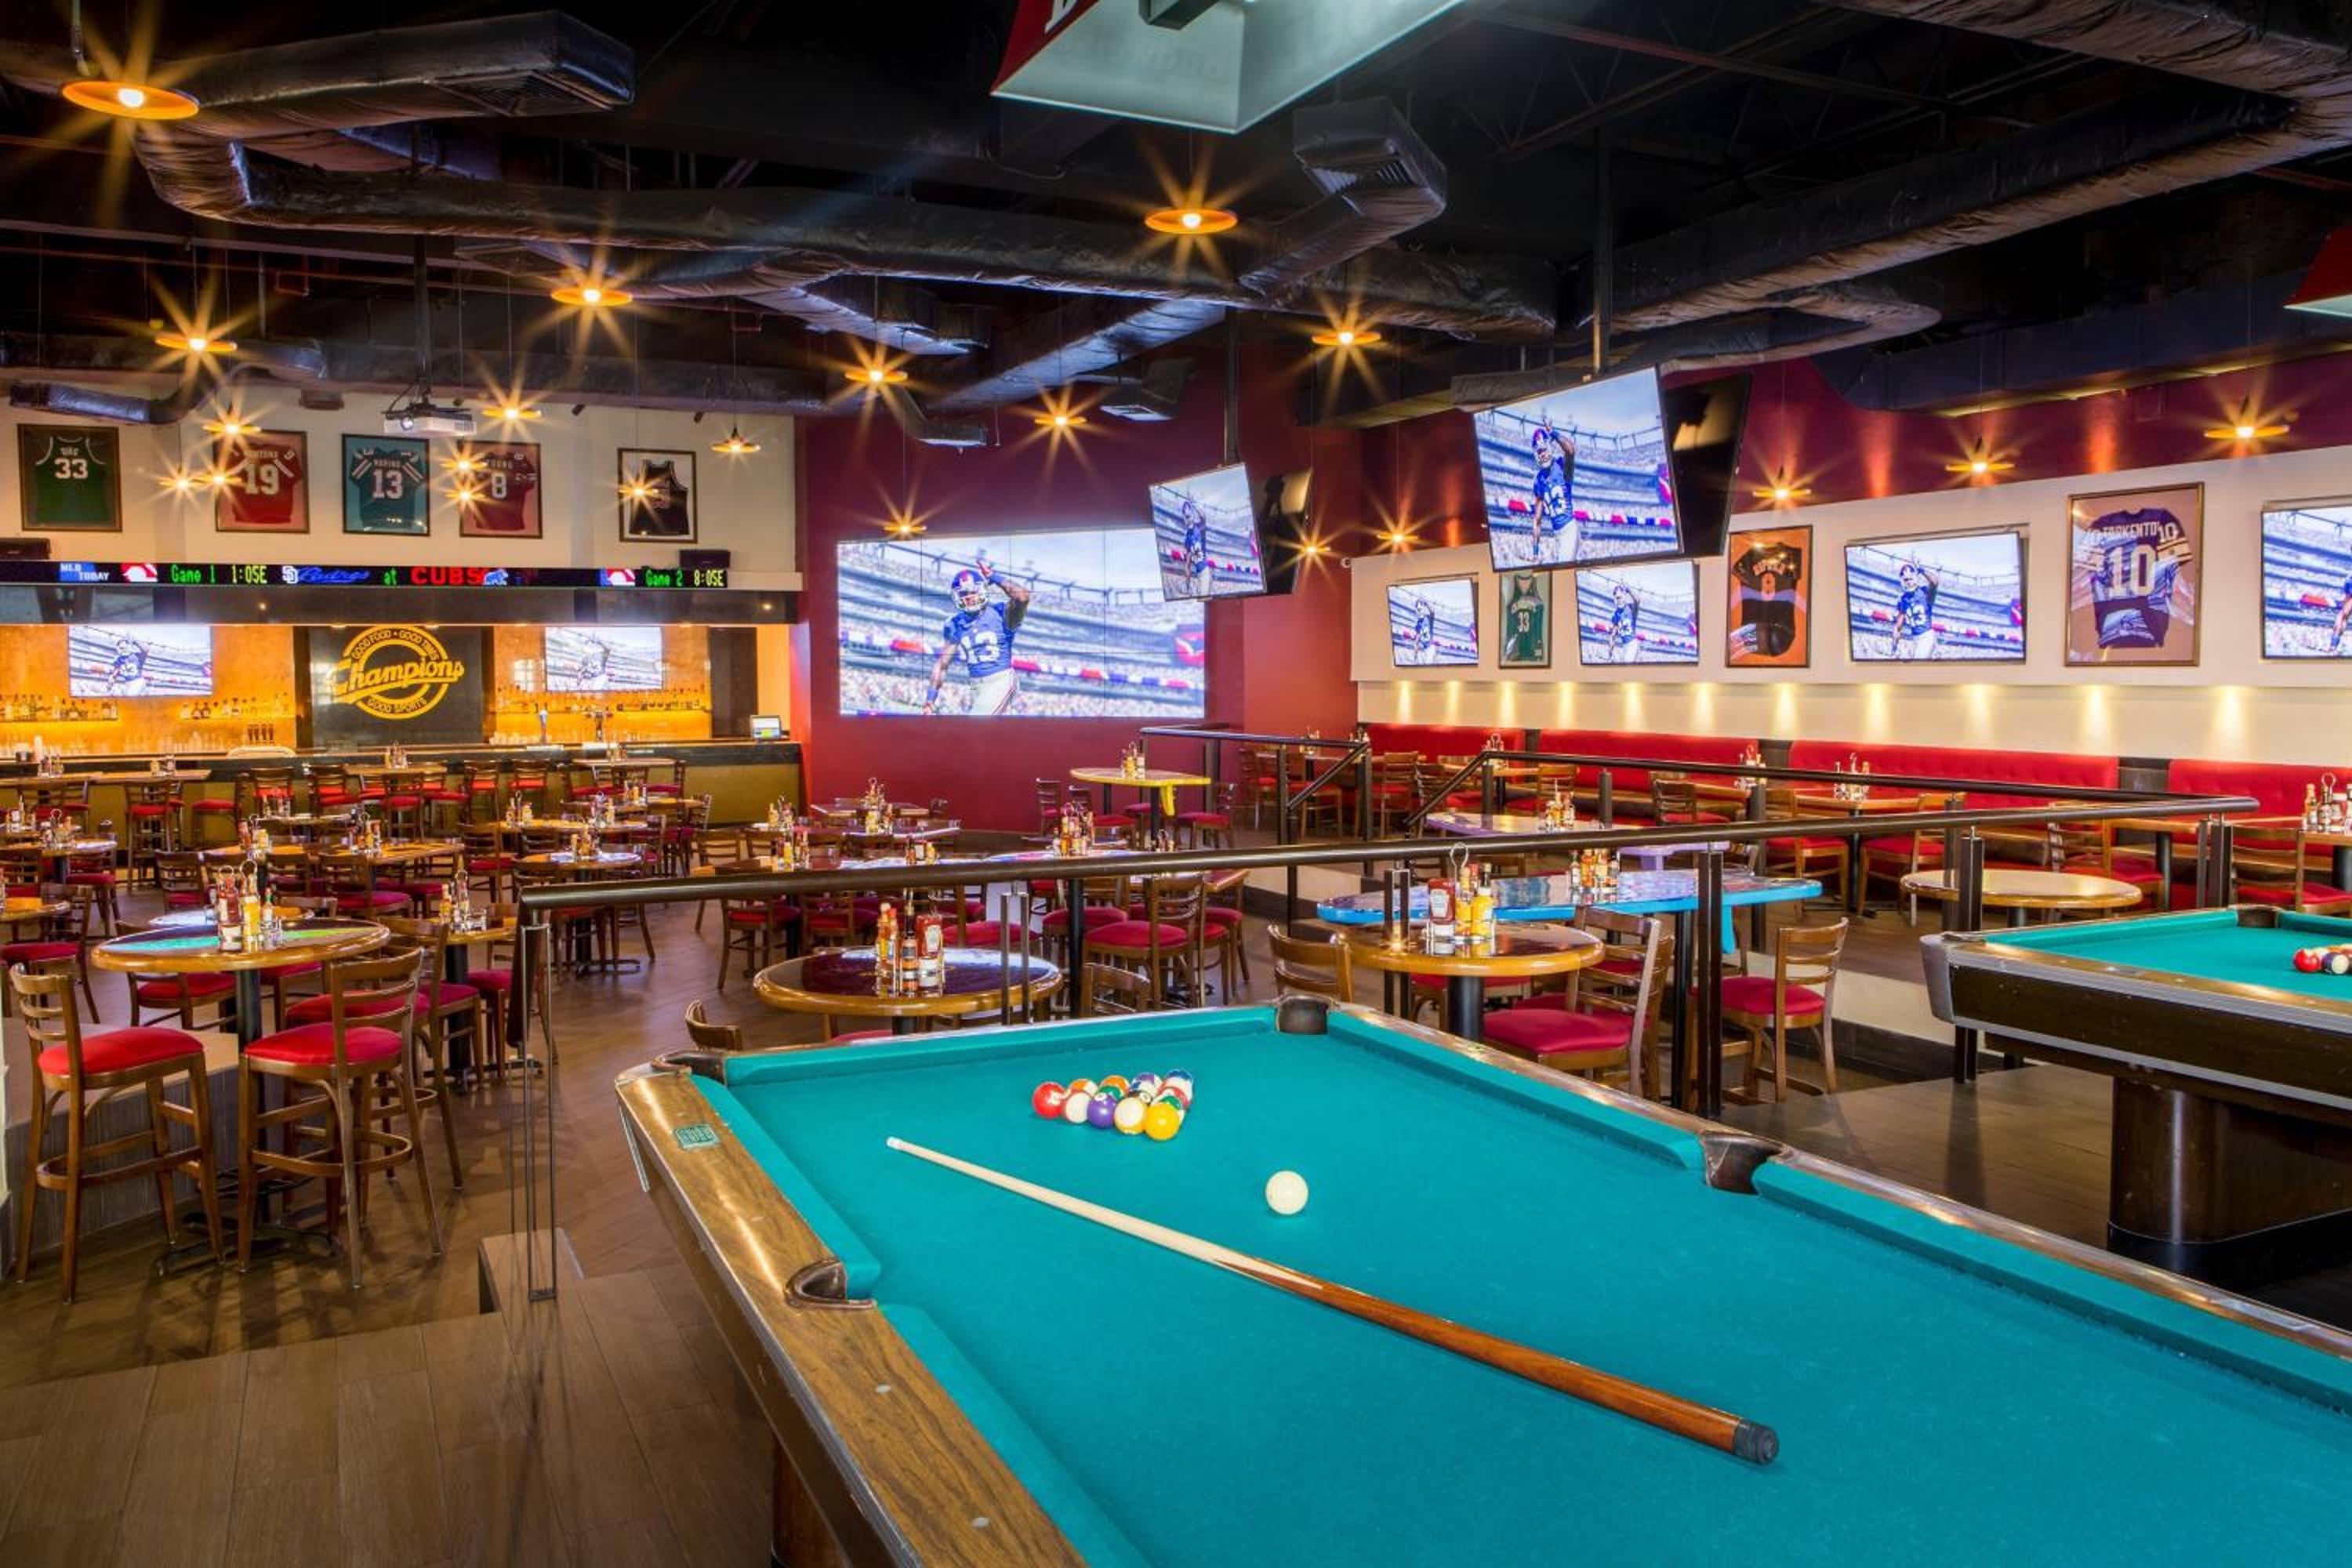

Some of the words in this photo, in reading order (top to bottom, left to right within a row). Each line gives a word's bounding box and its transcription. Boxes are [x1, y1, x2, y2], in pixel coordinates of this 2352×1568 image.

[54, 458, 88, 479] 33
[245, 463, 279, 495] 19
[372, 469, 402, 499] 13
[492, 472, 507, 498] 8
[2157, 523, 2180, 543] 10
[60, 563, 82, 572] MLB
[79, 572, 110, 581] TODAY
[170, 564, 201, 583] Game
[209, 564, 216, 584] 1
[383, 567, 397, 586] at
[410, 566, 485, 586] CUBS
[646, 569, 670, 586] Game
[677, 569, 683, 586] 2
[2109, 544, 2157, 597] 10
[351, 638, 371, 659] GOOD
[370, 630, 391, 644] FOOD
[399, 630, 423, 644] GOOD
[326, 656, 465, 695] Champions
[367, 697, 392, 713] GOOD
[394, 696, 427, 713] SPORTS
